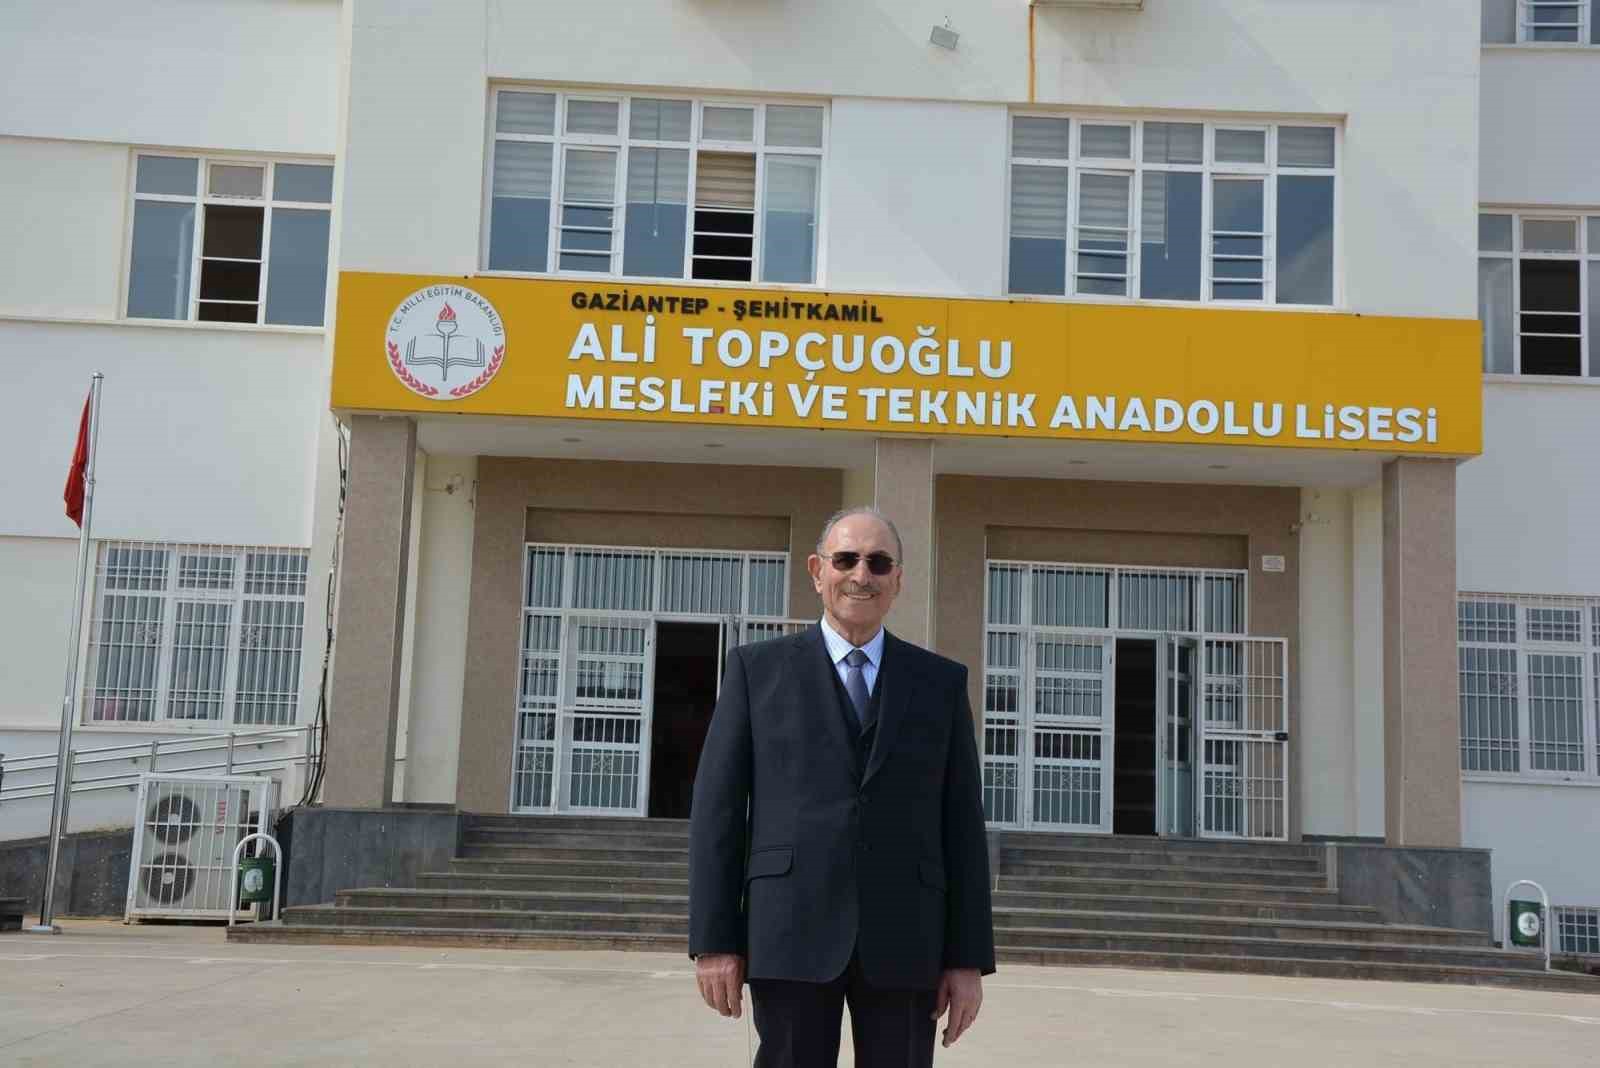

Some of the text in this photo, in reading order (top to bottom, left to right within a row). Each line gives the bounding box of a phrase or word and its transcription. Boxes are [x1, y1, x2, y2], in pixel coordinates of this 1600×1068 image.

[571, 290, 708, 314] GAZİANTEP
[733, 293, 884, 323] ŞEHİTKAMİL
[568, 314, 1012, 382] ALİ TOPÇUOĞLU
[788, 384, 848, 420] VE
[1050, 395, 1284, 437] ANADOLU
